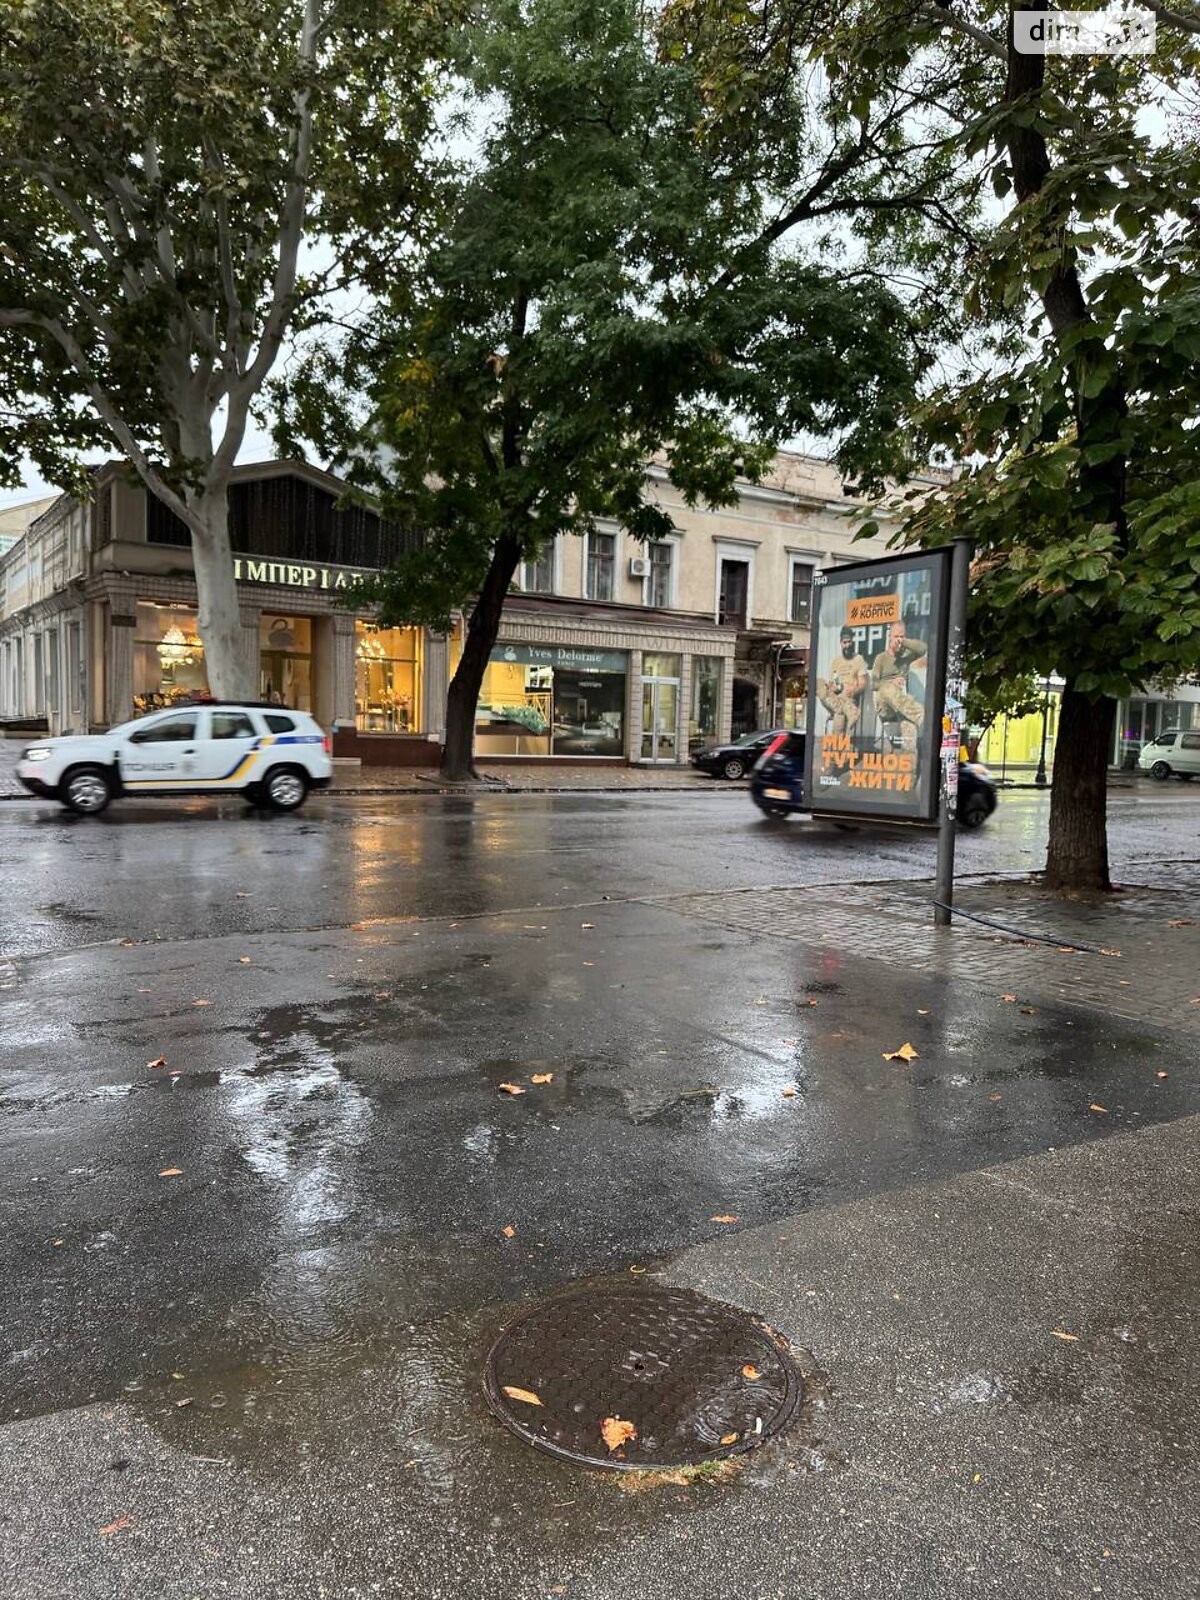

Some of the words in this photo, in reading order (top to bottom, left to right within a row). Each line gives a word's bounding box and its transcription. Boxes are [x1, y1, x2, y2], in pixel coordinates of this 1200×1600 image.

[528, 645, 553, 660] Yves
[822, 735, 851, 751] МИ
[823, 751, 858, 769] ТУТ
[848, 769, 912, 792] ЖИТИ
